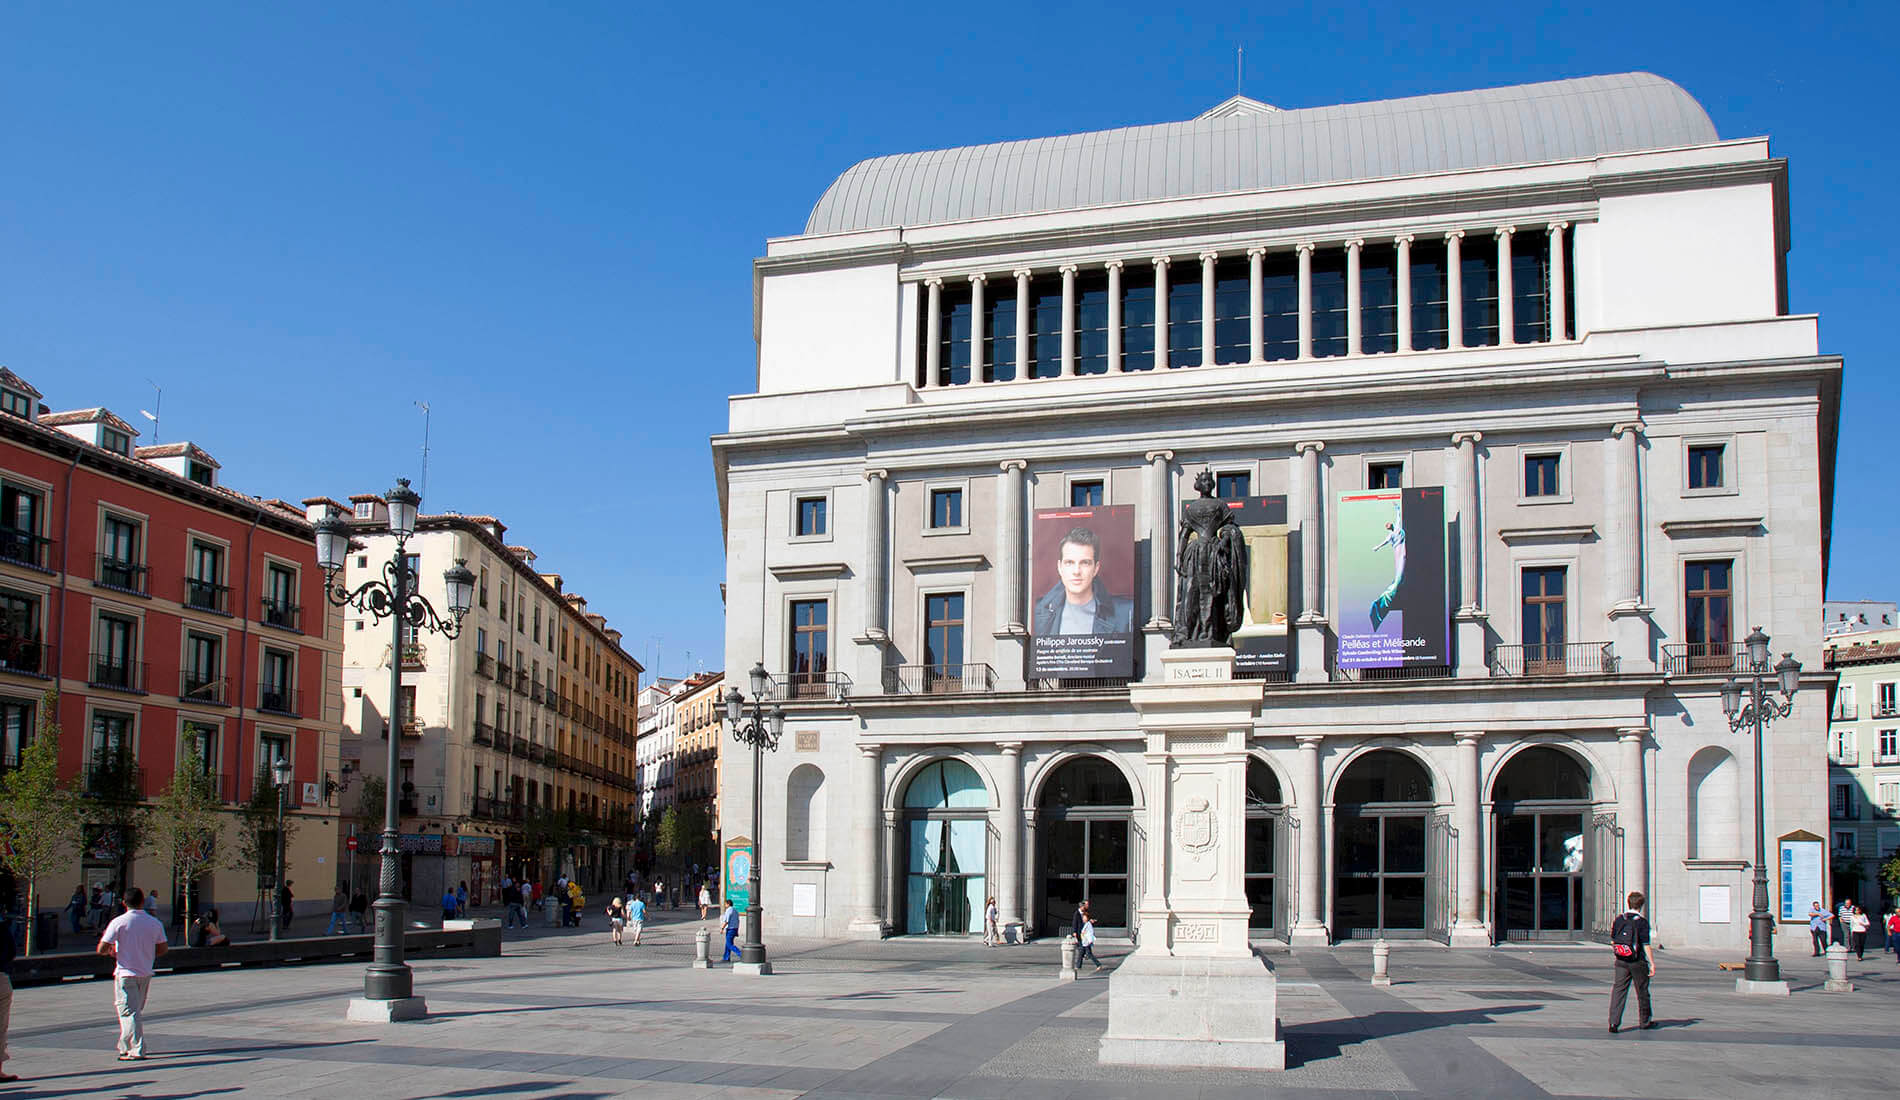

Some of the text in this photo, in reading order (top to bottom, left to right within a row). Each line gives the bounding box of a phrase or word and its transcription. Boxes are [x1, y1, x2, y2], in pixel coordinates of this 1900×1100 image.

[1036, 637, 1065, 648] Philippe
[1067, 637, 1103, 647] Jaroussky
[1342, 637, 1426, 649] Pelléas et Mélisande
